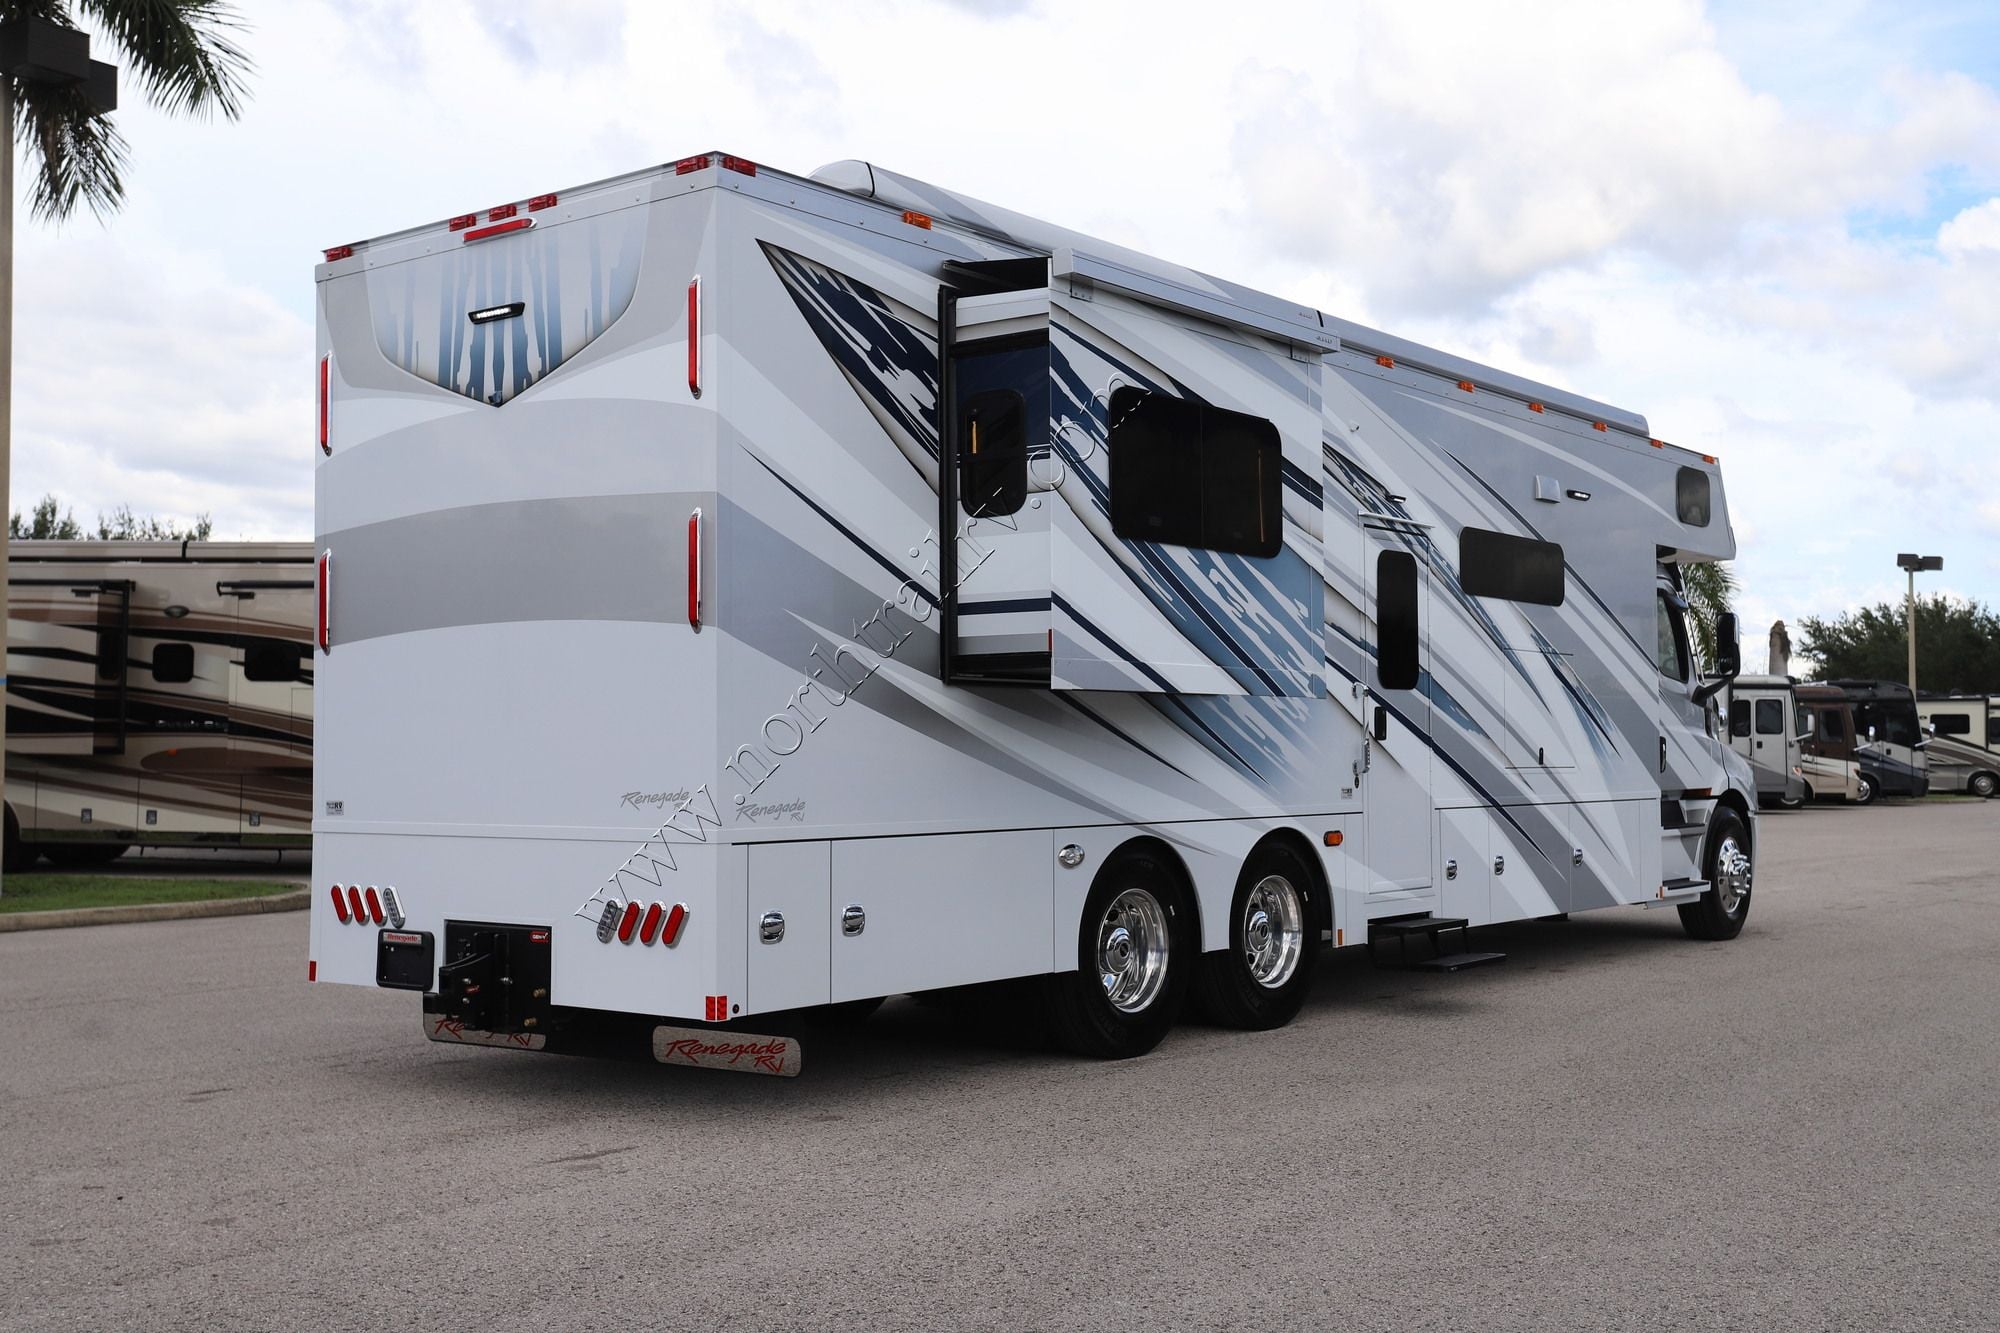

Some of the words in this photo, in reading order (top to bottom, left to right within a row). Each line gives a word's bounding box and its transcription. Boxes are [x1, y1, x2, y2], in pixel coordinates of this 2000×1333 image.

[620, 786, 690, 811] Renegade
[736, 797, 806, 823] Renegade
[791, 812, 805, 822] RV
[666, 1038, 787, 1065] Renegade
[753, 1054, 785, 1073] RV
